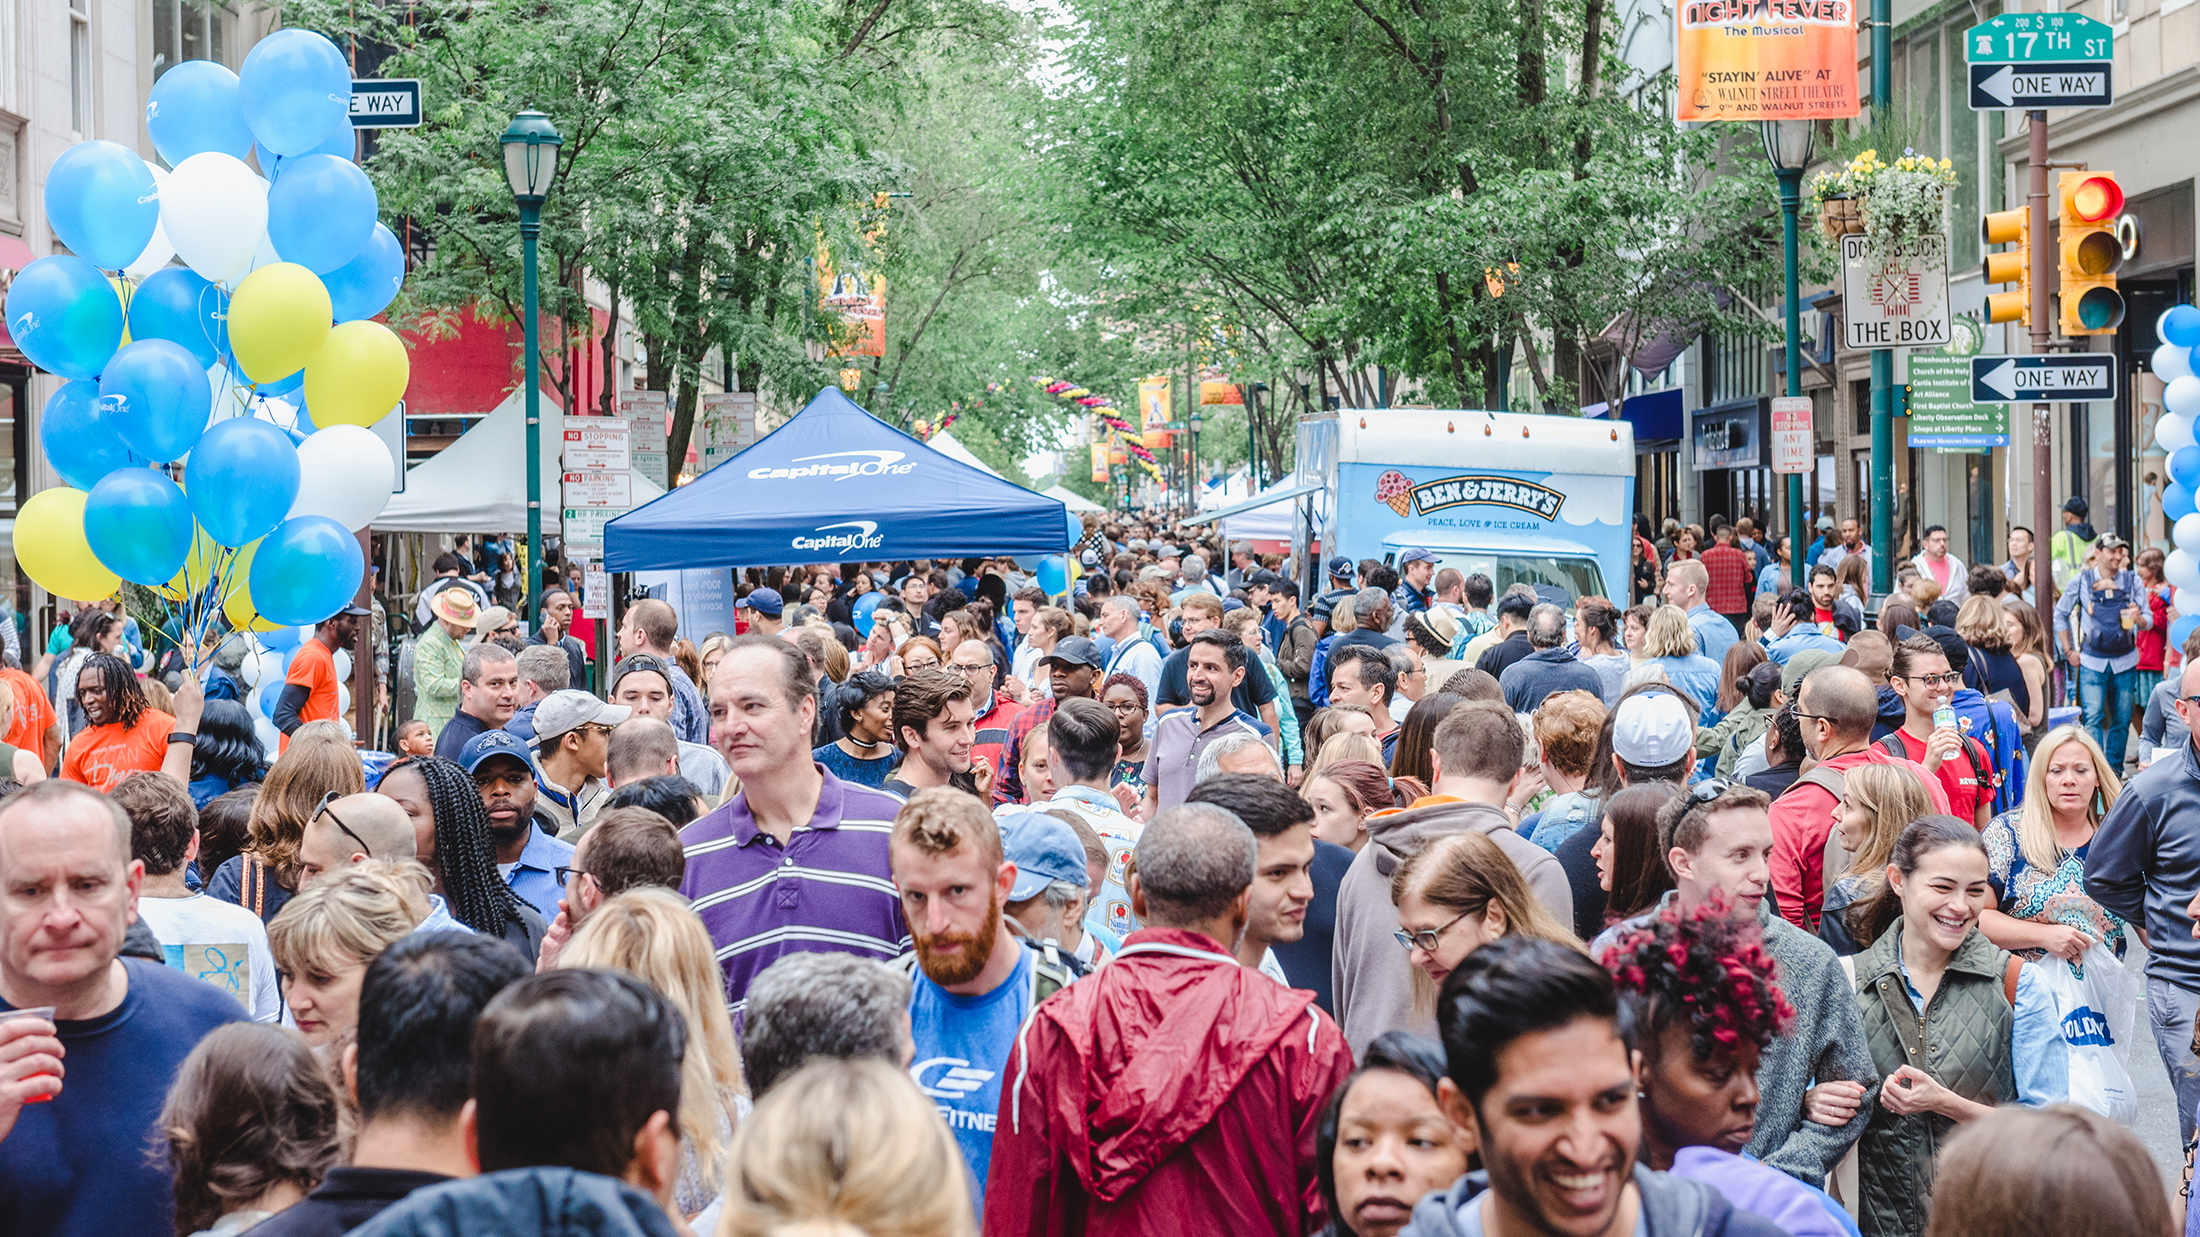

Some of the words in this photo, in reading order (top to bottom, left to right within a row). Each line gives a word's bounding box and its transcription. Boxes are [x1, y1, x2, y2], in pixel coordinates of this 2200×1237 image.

[1768, 0, 1848, 21] FEVER
[2015, 18, 2030, 28] 200
[2036, 15, 2045, 30] S
[2051, 17, 2064, 27] 100
[1724, 26, 1748, 36] The
[1752, 25, 1805, 36] Musical
[2084, 39, 2106, 57] ST
[1816, 69, 1832, 80] AT
[2012, 77, 2052, 94] ONE
[2059, 76, 2097, 93] WAY
[1718, 87, 1758, 101] WALNUT
[1760, 86, 1799, 100] STREET
[1802, 84, 1846, 99] THEATRE
[367, 95, 404, 112] WAY
[1736, 104, 1758, 112] AND
[1762, 102, 1805, 111] WALNUT
[1808, 101, 1847, 109] STREETS
[1853, 321, 1891, 343] THE
[1901, 319, 1942, 341] BOX
[1912, 356, 1950, 364] Rittenhouse
[1951, 356, 1970, 365] Squar
[1912, 368, 1935, 376] Church
[1935, 368, 1943, 376] of
[1943, 368, 1954, 376] the
[1955, 368, 1970, 377] Holy
[2014, 370, 2055, 387] ONE
[2062, 369, 2099, 386] WAY
[1913, 391, 1924, 399] Art
[1924, 391, 1950, 399] Alliance
[1913, 402, 1928, 410] First
[1928, 402, 1950, 411] Baptist
[1951, 402, 1974, 410] Church
[1786, 412, 1797, 422] NO
[1913, 414, 1935, 422] Liberty
[1973, 413, 1989, 421] Deck
[1775, 420, 1809, 430] STOPPING
[1913, 425, 1933, 434] Shops
[1942, 425, 1964, 434] Liberty
[1964, 425, 1982, 433] Place
[568, 432, 579, 440] NO
[584, 432, 624, 441] STOPPING
[1783, 434, 1801, 444] ANY
[1782, 447, 1804, 457] TIME
[569, 474, 581, 482] NO
[584, 475, 616, 483] PARKING
[1428, 518, 1457, 528] PEACE,
[1459, 518, 1481, 527] LOVE
[1494, 520, 1508, 528] ICE
[1510, 521, 1540, 531] CREAM
[935, 1105, 998, 1132] FITNE
